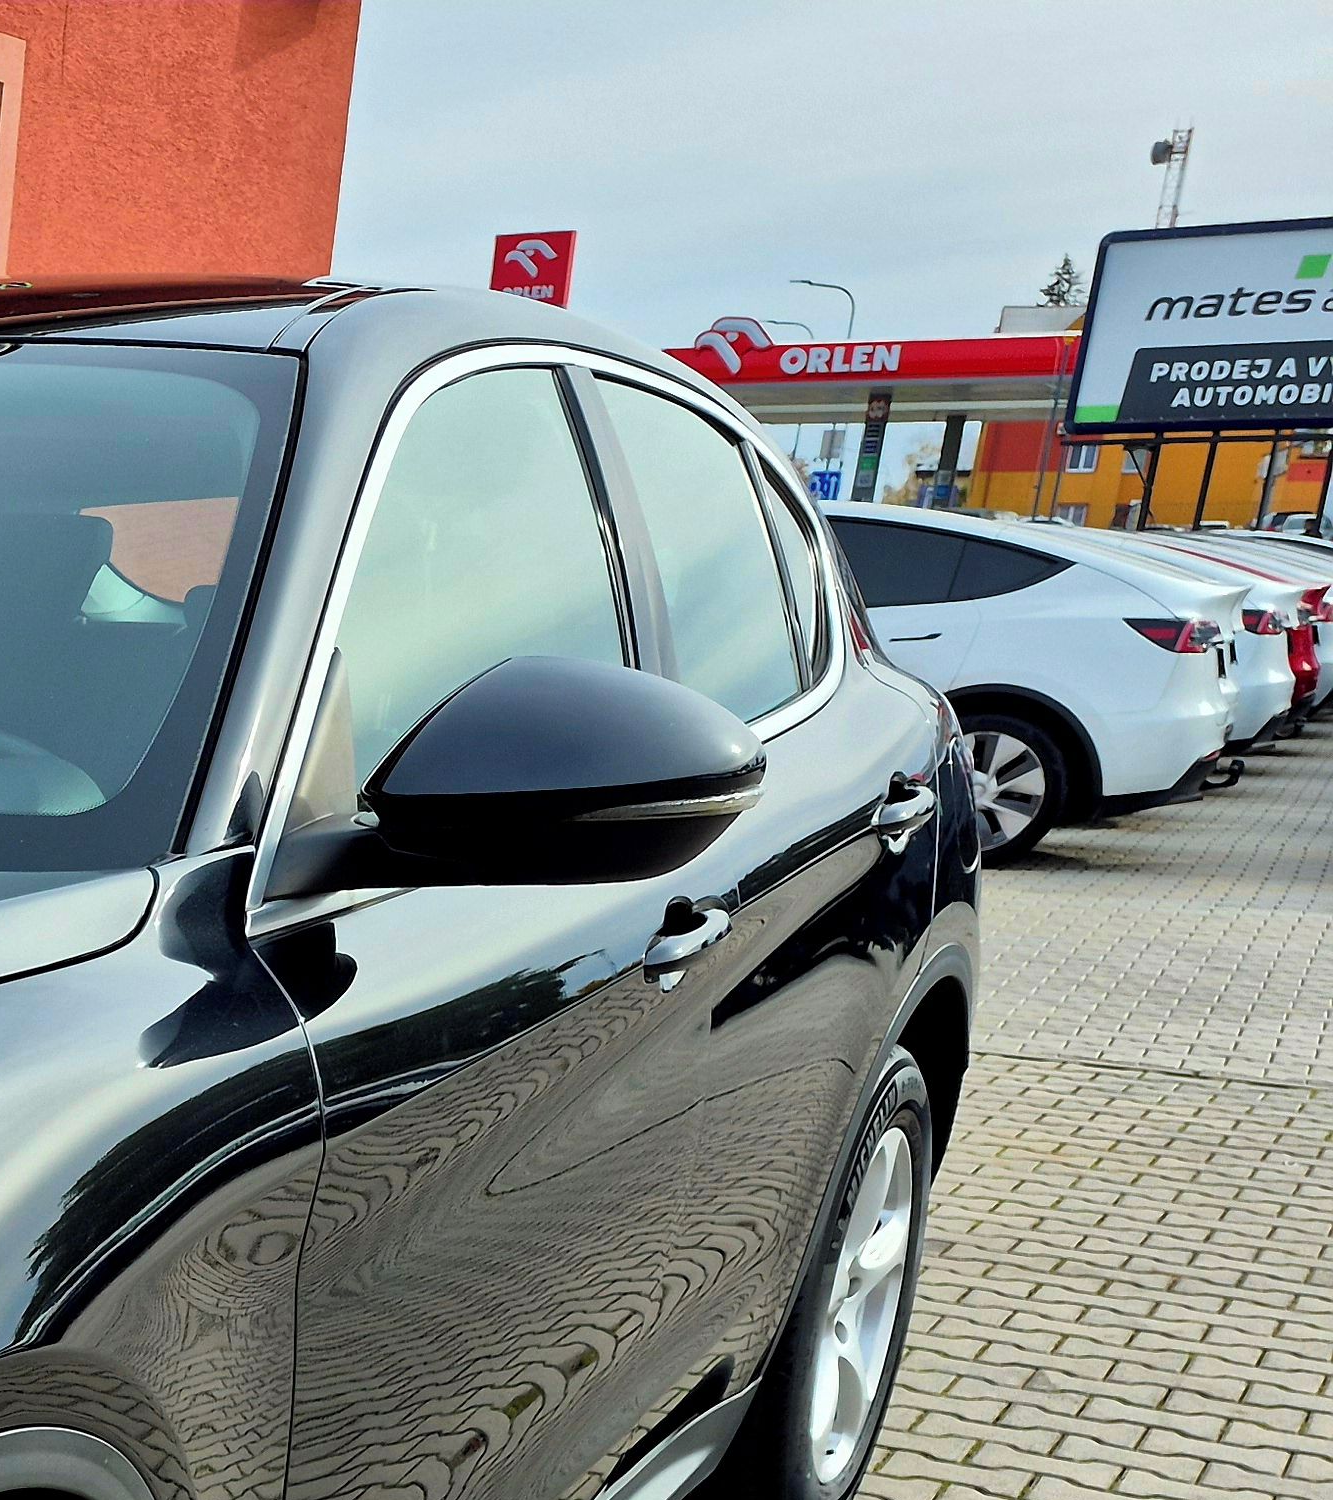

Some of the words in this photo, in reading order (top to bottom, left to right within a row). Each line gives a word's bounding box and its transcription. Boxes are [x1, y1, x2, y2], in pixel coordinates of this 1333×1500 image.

[1144, 287, 1317, 321] mates
[779, 344, 902, 375] ORLEN
[1149, 358, 1273, 382] PRODEJ
[1275, 357, 1297, 378] A
[1308, 356, 1333, 377] V
